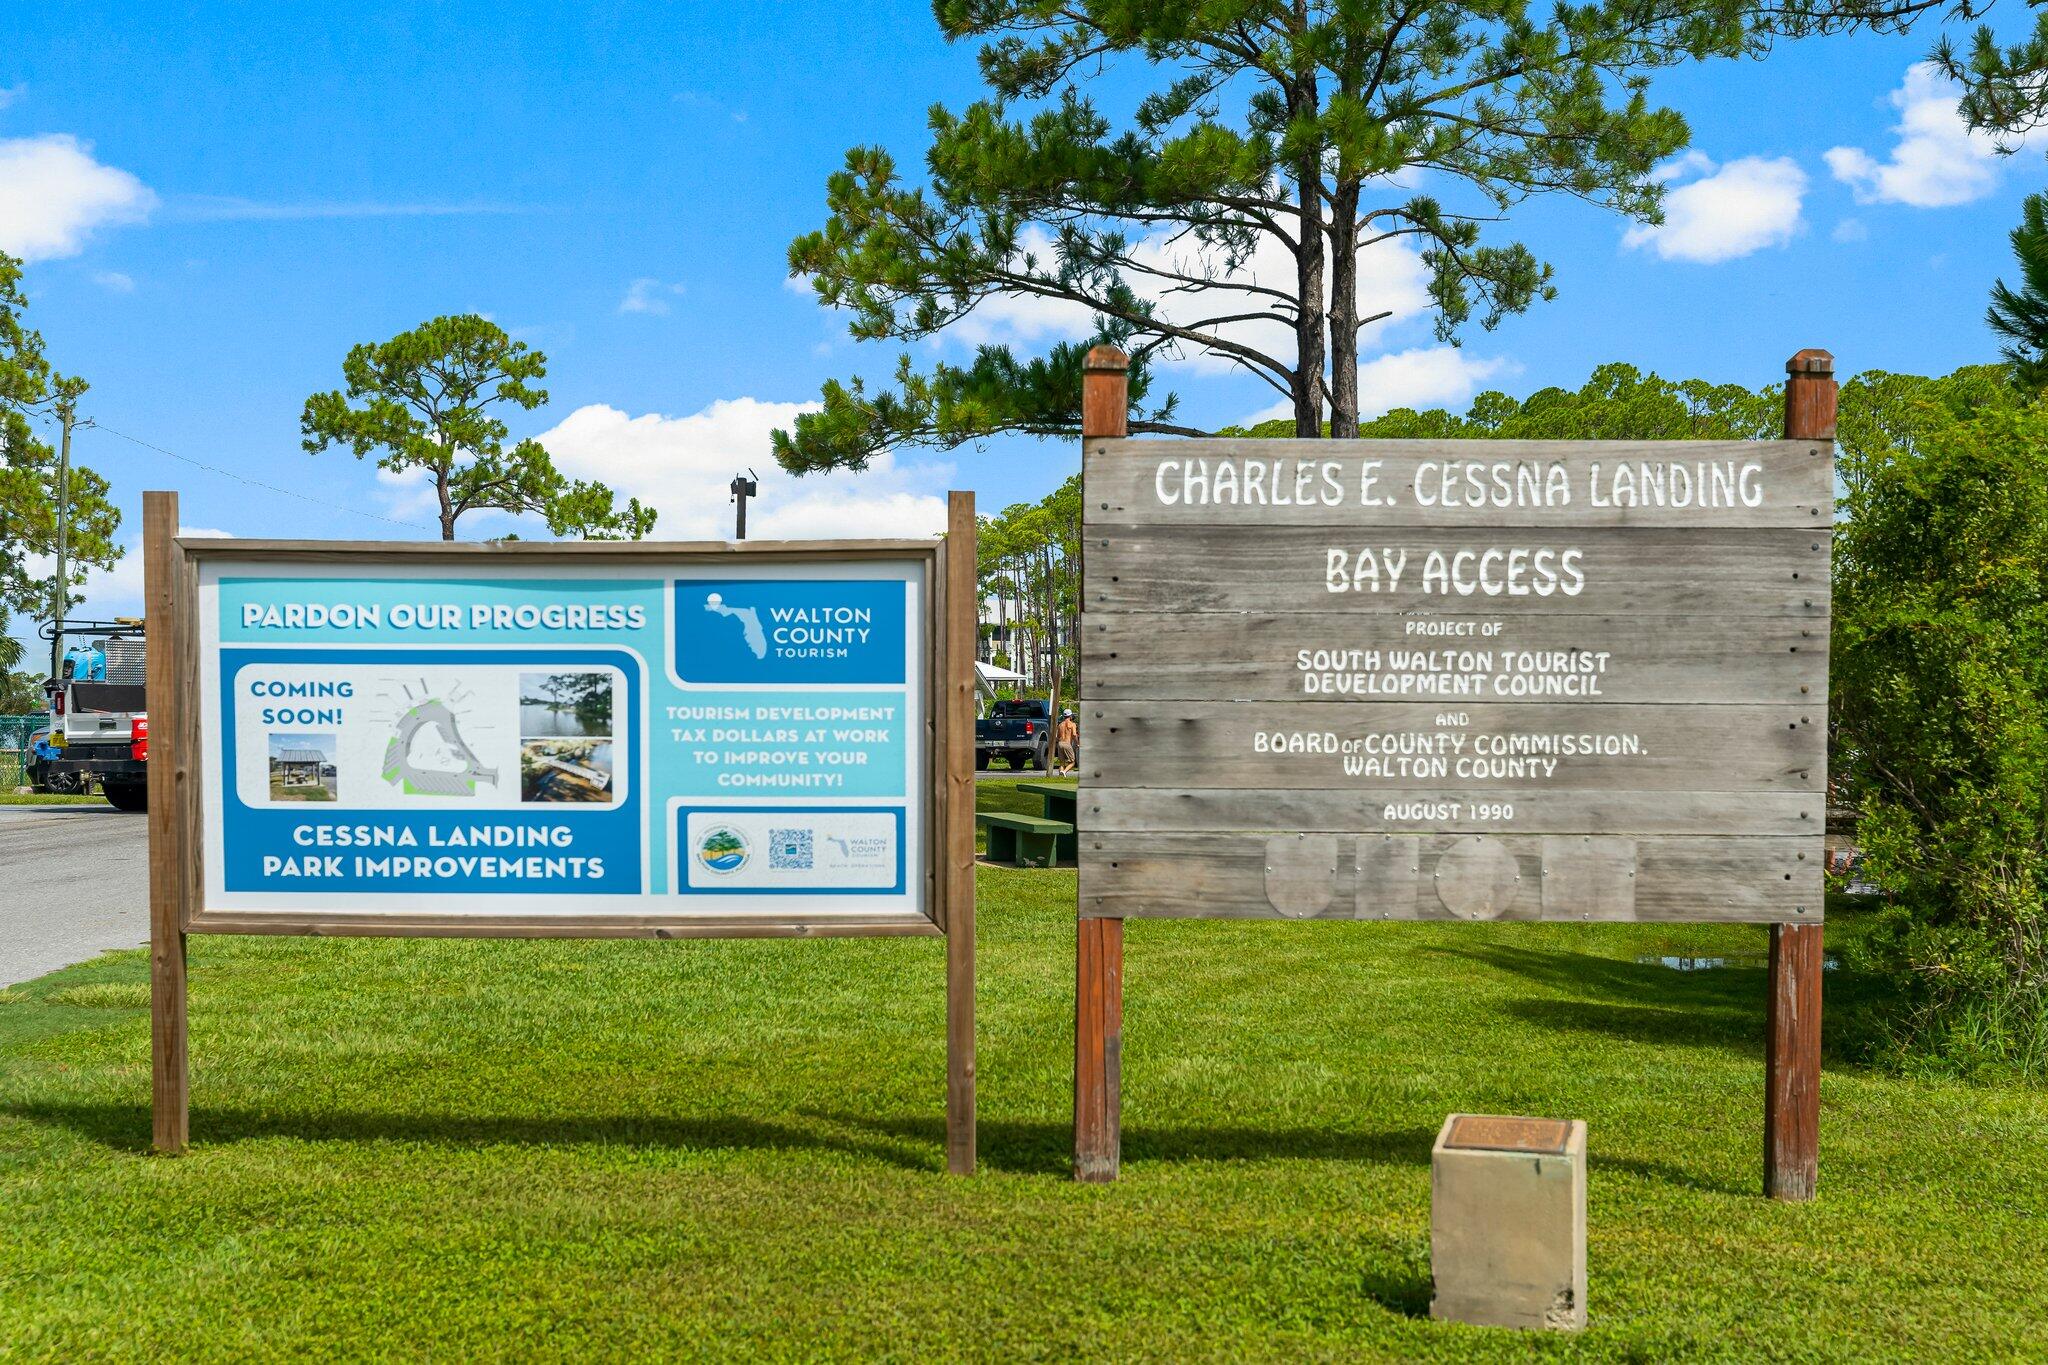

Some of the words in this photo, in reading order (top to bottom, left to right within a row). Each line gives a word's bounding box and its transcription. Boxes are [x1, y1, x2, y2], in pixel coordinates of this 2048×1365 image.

[1155, 458, 1345, 507] CHARLES
[1360, 460, 1397, 507] E.
[1414, 461, 1571, 508] CESSNA
[1590, 461, 1763, 508] LANDING
[1325, 547, 1407, 593] BAY
[1422, 547, 1585, 597] ACCESS
[242, 603, 381, 629] PARDON
[388, 603, 463, 629] OUR
[470, 604, 647, 630] PROGRESS
[770, 607, 871, 624] WALTON
[773, 627, 870, 644] COUNTY
[1405, 621, 1477, 636] PROJECT
[1481, 622, 1503, 637] OF
[775, 647, 848, 659] TOURISM
[1296, 649, 1381, 671] SOUTH
[1388, 650, 1493, 672] WALTON
[1499, 651, 1611, 673] TOURIST
[250, 680, 353, 698] COMING
[1304, 672, 1488, 695] DEVELOPMENT
[1493, 674, 1603, 697] COUNCIL
[262, 708, 342, 725] SOON!
[666, 706, 750, 721] TOURISM
[755, 707, 895, 721] DEVELOPMENT
[1435, 712, 1470, 726] AND
[671, 728, 706, 742] TAX
[712, 728, 799, 743] DOLLARS
[804, 729, 827, 743] AT
[832, 729, 889, 743] WORK
[1254, 731, 1339, 754] BOARD
[1364, 732, 1466, 755] COUNTY
[1474, 733, 1648, 756] COMMISSION.
[693, 750, 719, 765] TO
[724, 751, 808, 765] IMPROVE
[815, 751, 868, 765] YOUR
[1343, 755, 1448, 778] WALTON
[1455, 757, 1558, 779] COUNTY
[717, 773, 843, 787] COMMUNITY!
[1383, 803, 1462, 821] AUGUST
[1470, 804, 1514, 820] 1990
[293, 825, 418, 847] CESSNA
[428, 825, 573, 848] LANDING
[263, 855, 344, 877] PARK
[355, 856, 605, 879] IMPROVEMENTS
